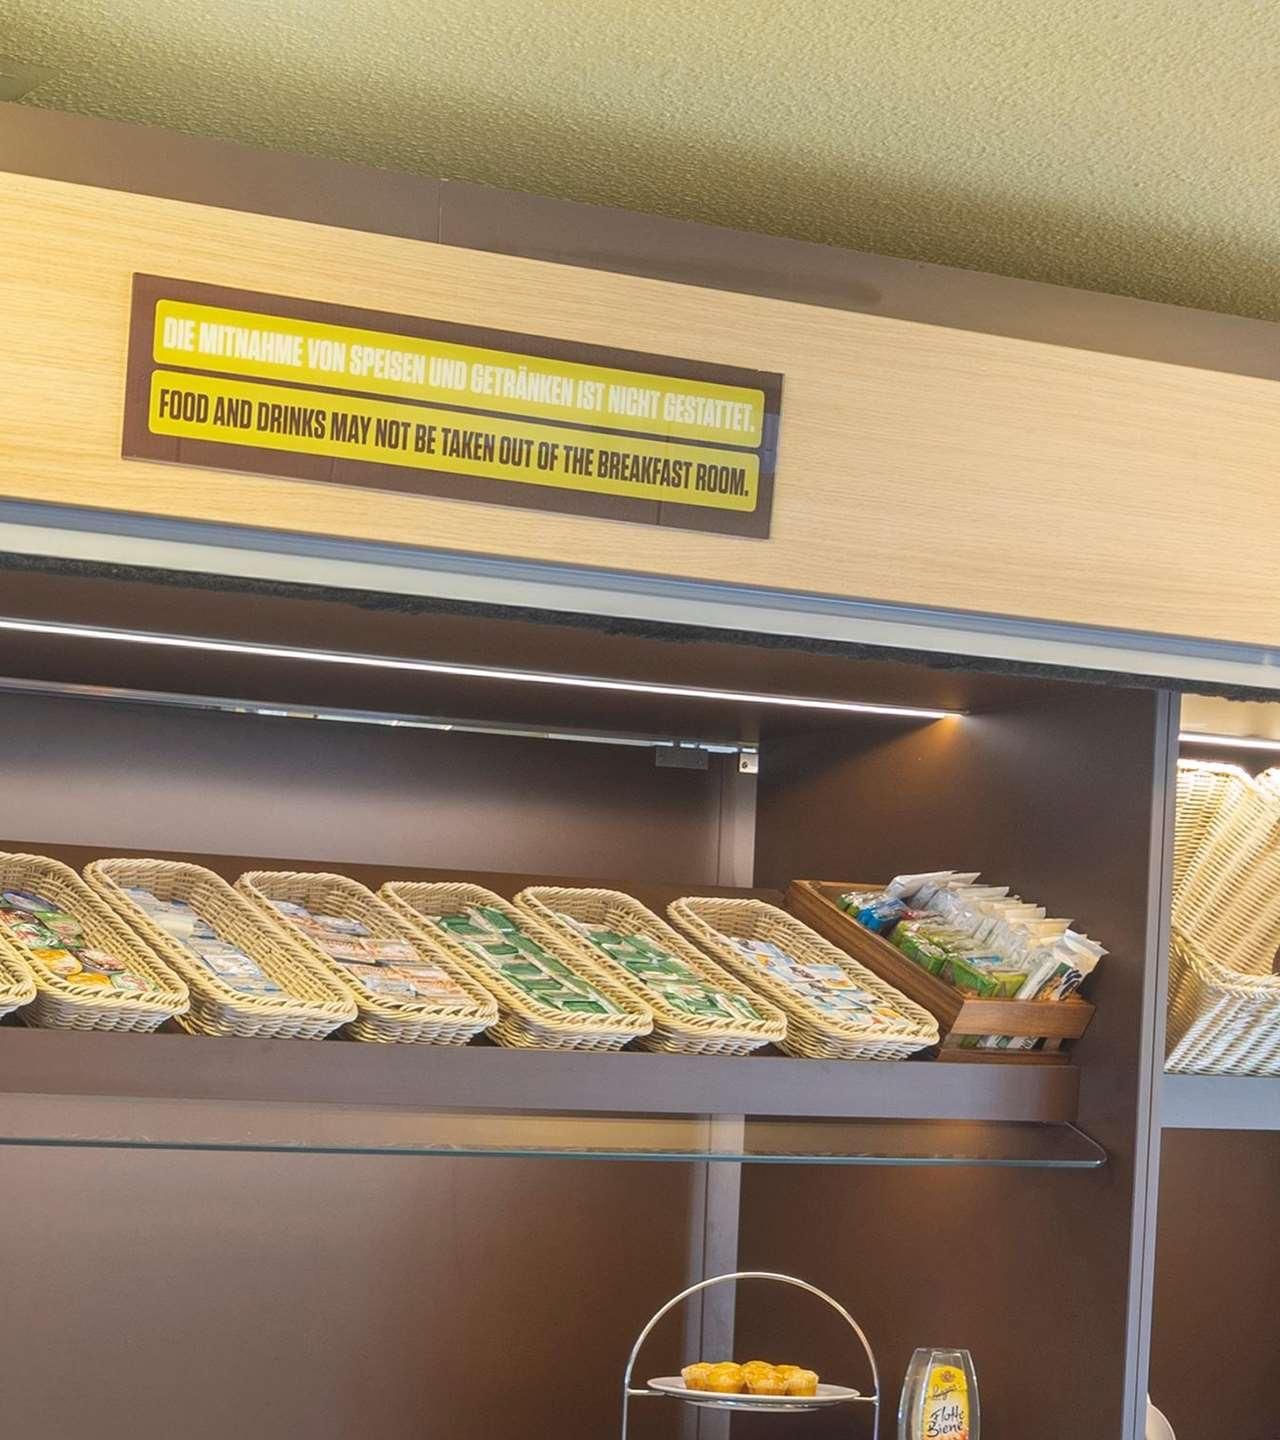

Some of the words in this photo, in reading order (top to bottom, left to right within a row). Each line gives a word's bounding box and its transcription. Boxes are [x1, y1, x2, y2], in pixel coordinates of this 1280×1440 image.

[163, 316, 194, 352] DIE
[198, 322, 303, 367] MITNAHME
[307, 339, 346, 374] VON
[350, 344, 426, 387] SPEISEN
[428, 354, 467, 391] UND
[470, 362, 573, 408] GETRÄNKEN
[576, 379, 606, 412] IST
[608, 383, 661, 420] NICHT
[663, 391, 756, 432] GESTATTET.
[159, 388, 209, 424] FOOD
[213, 396, 252, 430] AND
[256, 401, 326, 441] DRINKS
[330, 412, 372, 446] MAY
[374, 419, 411, 451] NOT
[414, 424, 437, 456] BE
[440, 427, 496, 463] TAKEN
[498, 435, 534, 469] OUT
[538, 441, 559, 472] OF
[562, 445, 593, 477] THE
[597, 450, 693, 490] BREAKFAST
[695, 463, 749, 497] ROOM.
